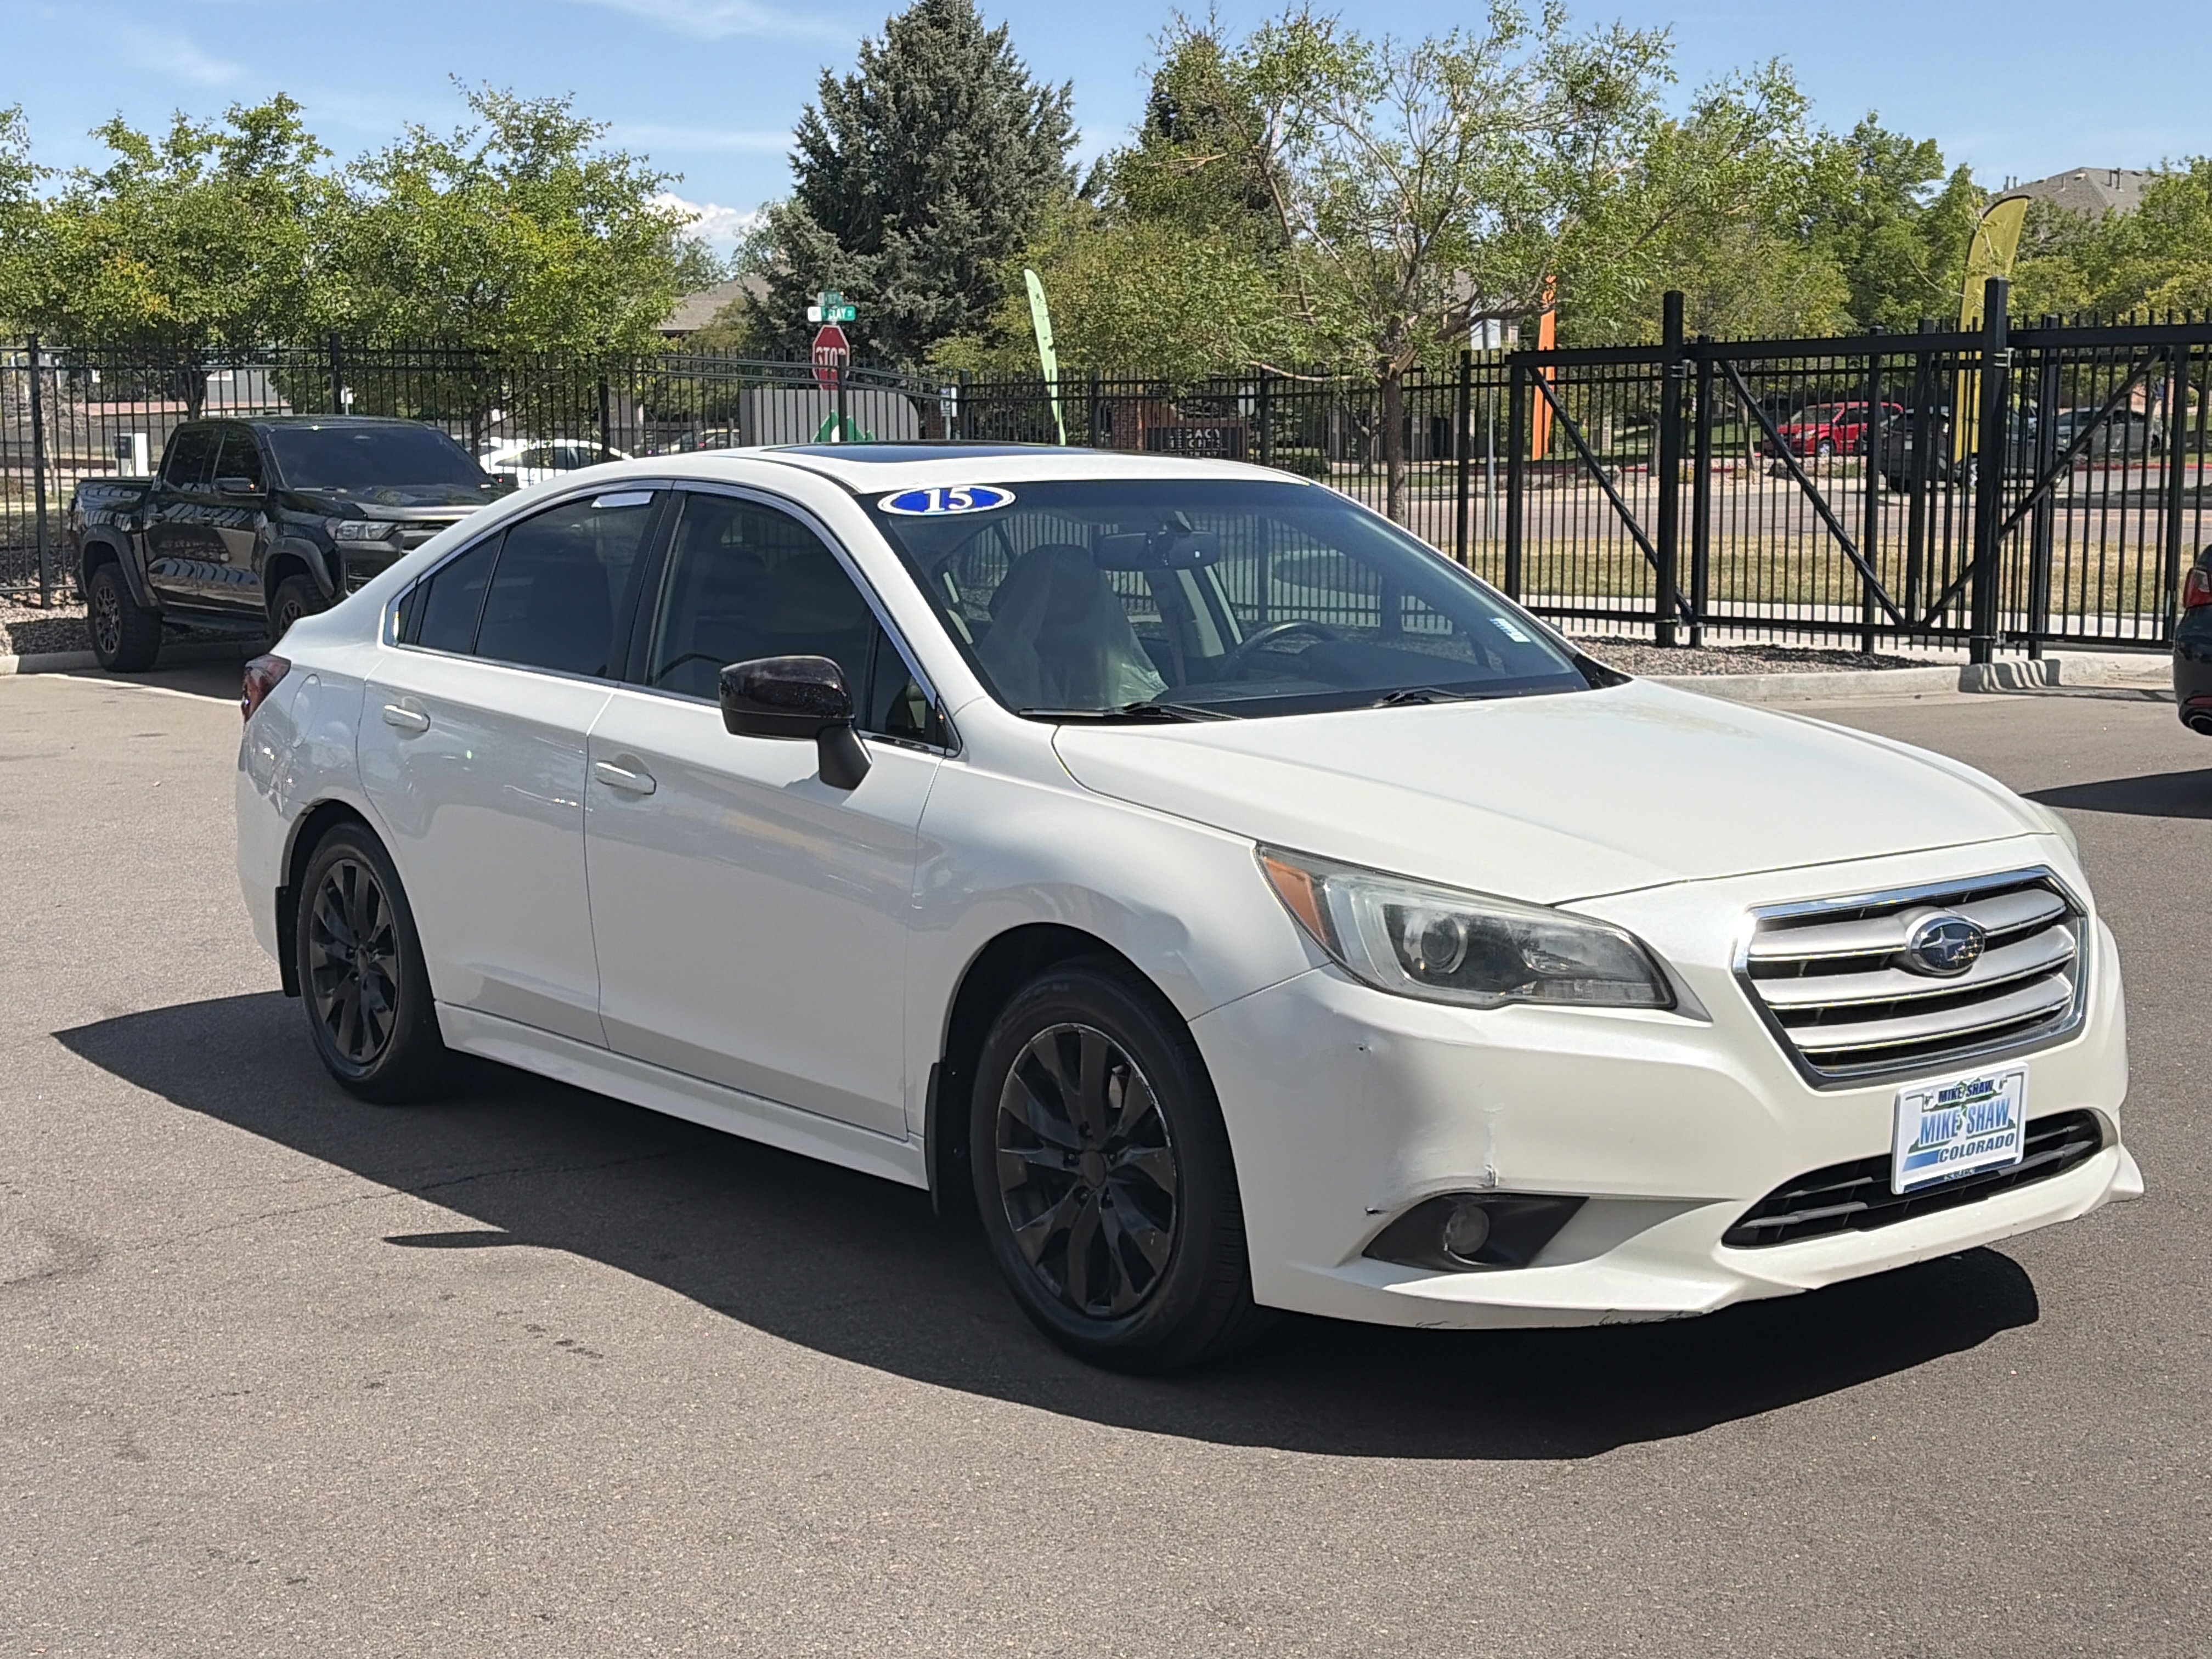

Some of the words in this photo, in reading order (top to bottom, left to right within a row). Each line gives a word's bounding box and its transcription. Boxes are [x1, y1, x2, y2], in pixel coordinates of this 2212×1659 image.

[924, 487, 973, 512] 15
[1938, 1086, 1963, 1103] MIKE
[1967, 1079, 1994, 1096] SHAW
[1921, 1109, 1961, 1145] MIKE
[1966, 1098, 2011, 1134] SHAW
[1939, 1133, 2015, 1163] COLORADO
